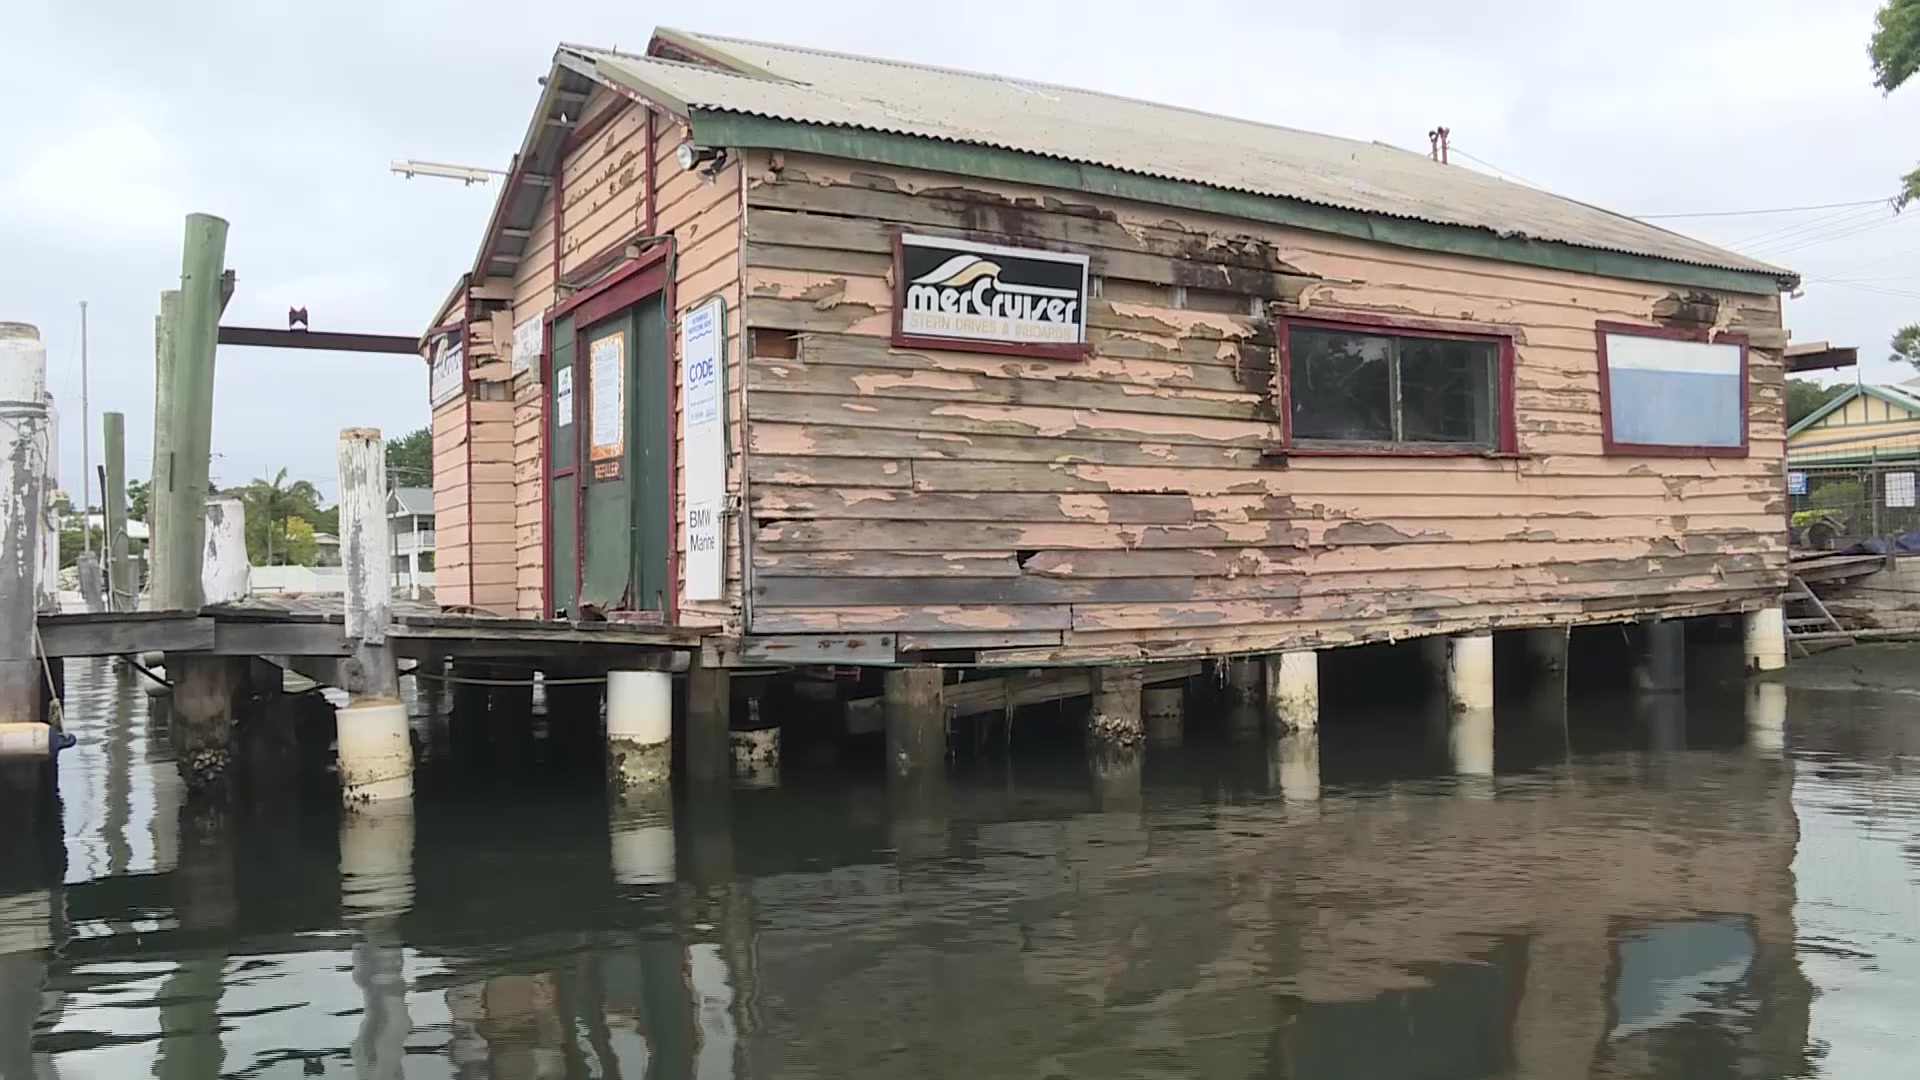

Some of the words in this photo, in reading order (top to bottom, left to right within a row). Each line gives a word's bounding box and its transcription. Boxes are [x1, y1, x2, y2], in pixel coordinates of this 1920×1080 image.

[911, 313, 949, 331] STERN
[955, 318, 998, 335] DRIVES
[690, 508, 711, 528] BMW
[690, 533, 715, 552] Marine
